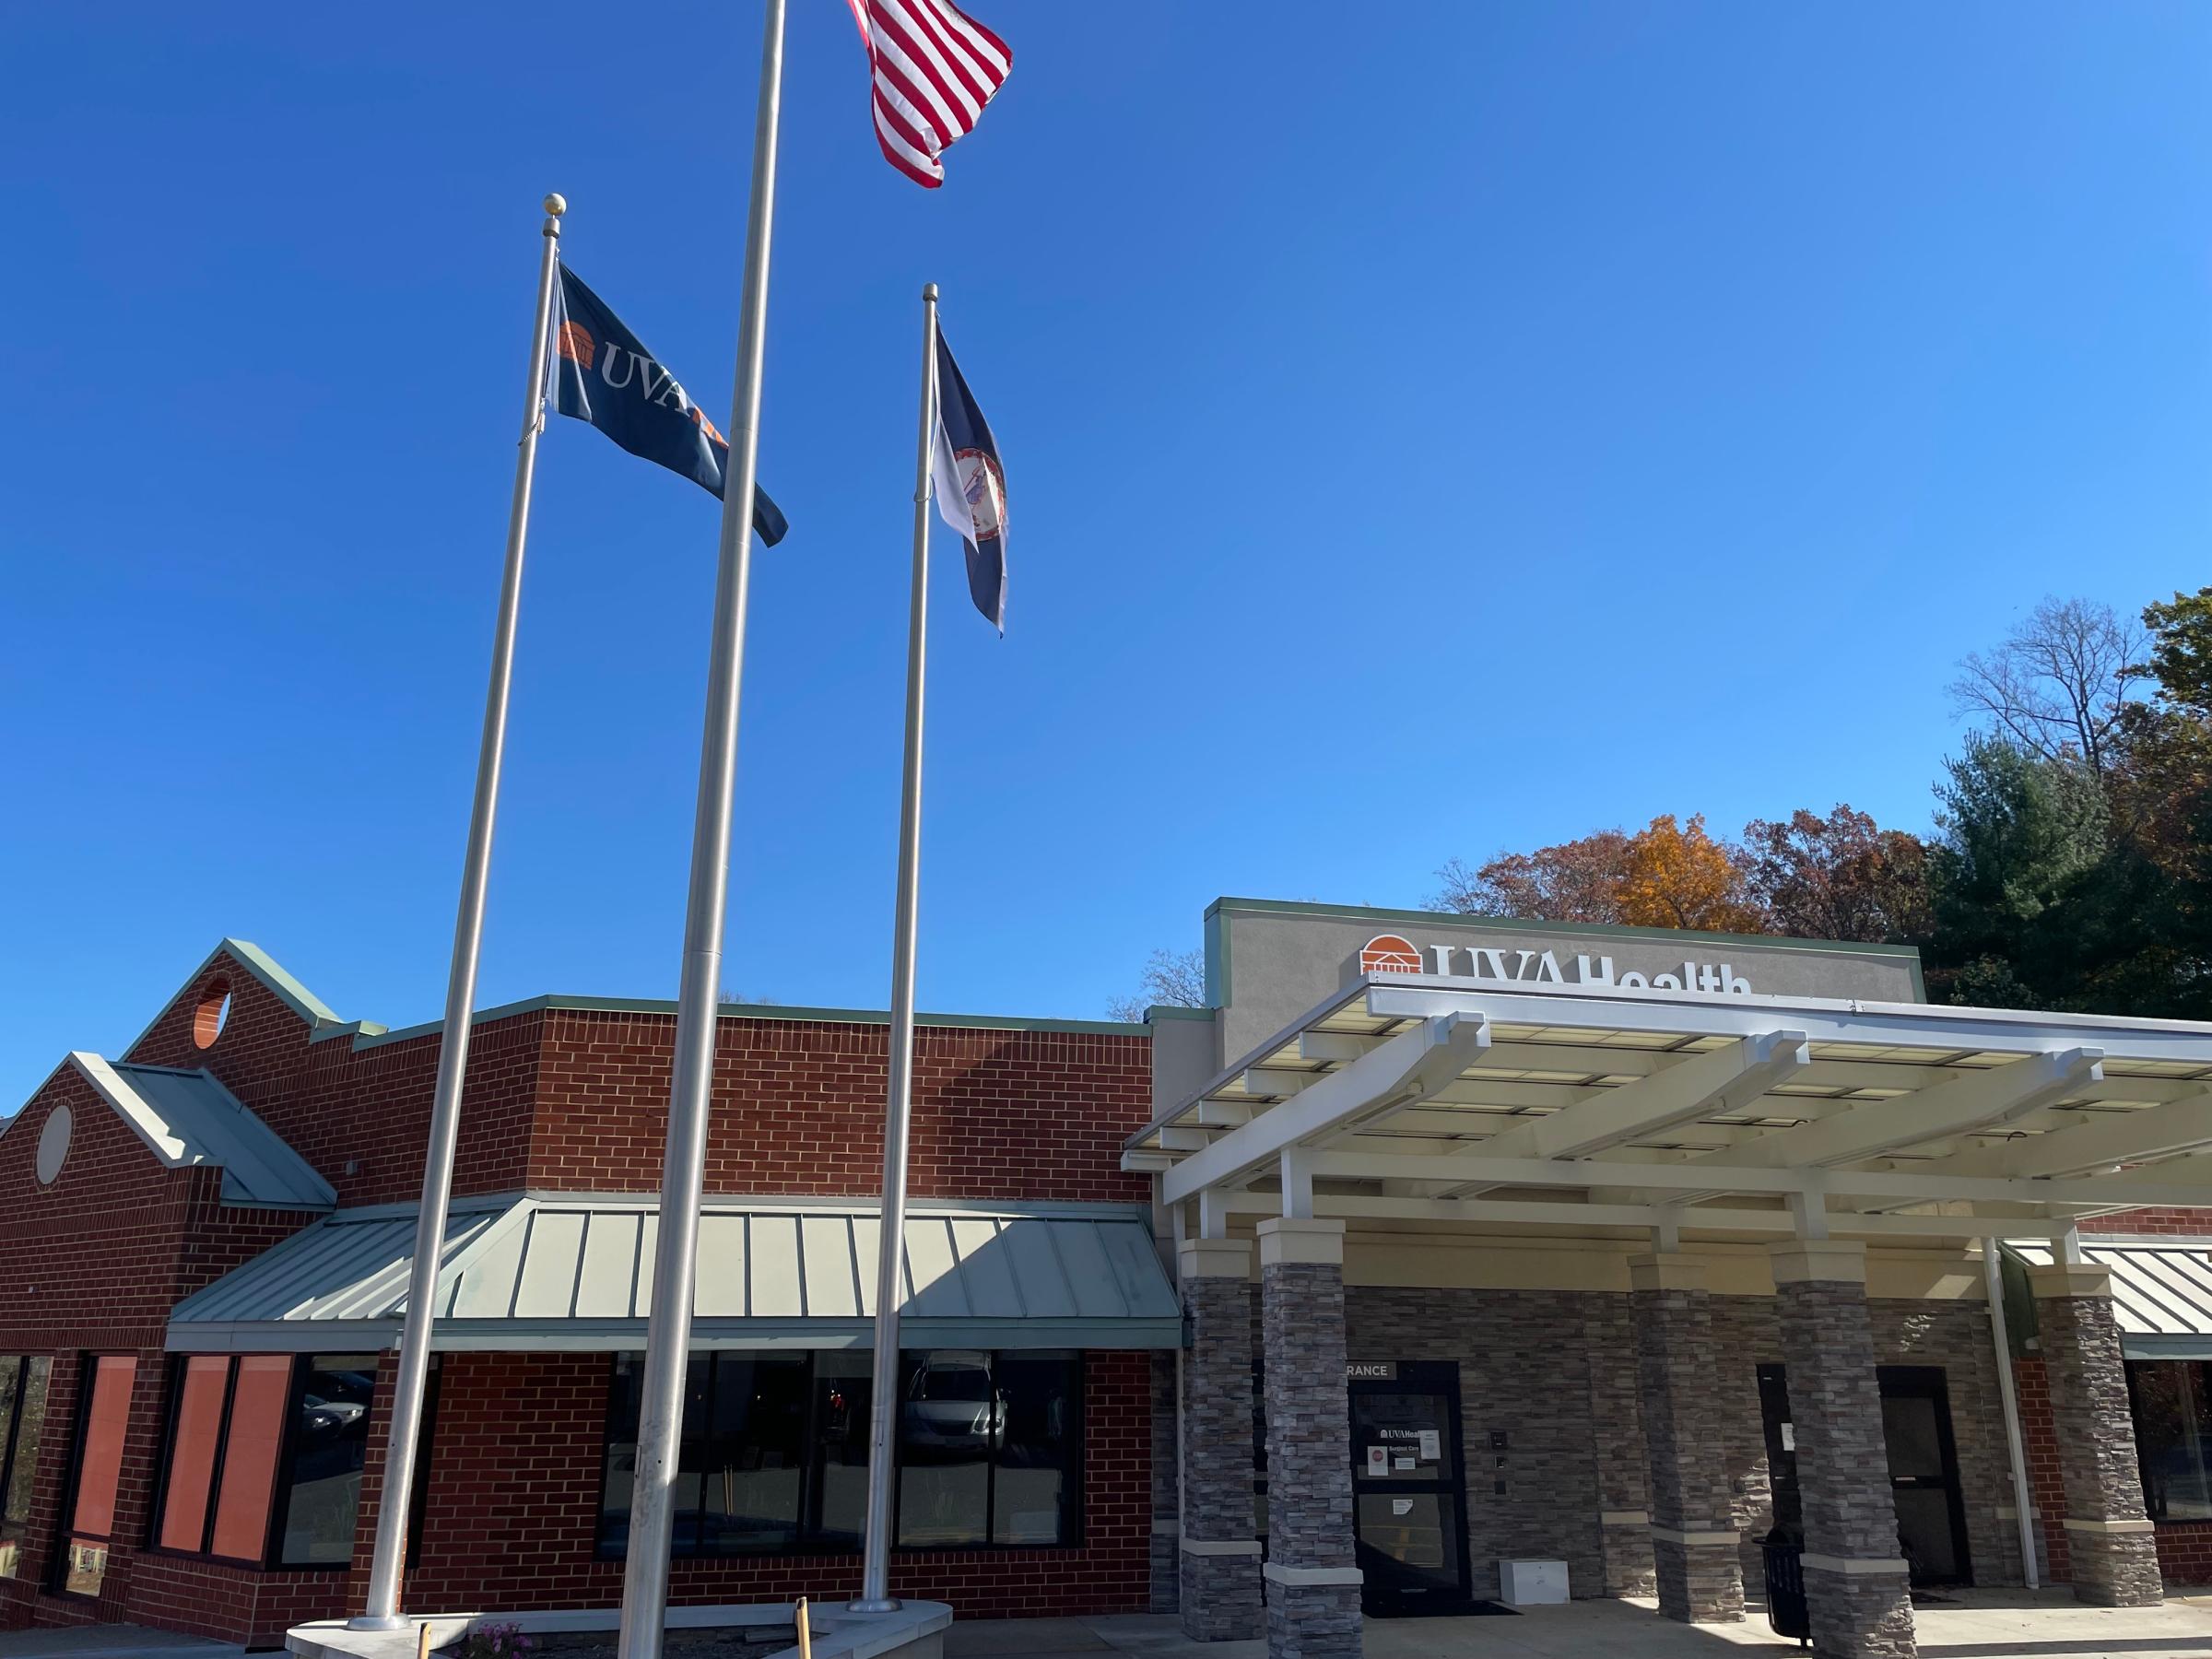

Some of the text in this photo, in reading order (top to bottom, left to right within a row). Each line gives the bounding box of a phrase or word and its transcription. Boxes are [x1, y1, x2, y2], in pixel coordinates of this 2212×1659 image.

[602, 341, 690, 418] UVA
[1347, 1365, 1388, 1376] RANCE
[1405, 1430, 1420, 1439] Heal
